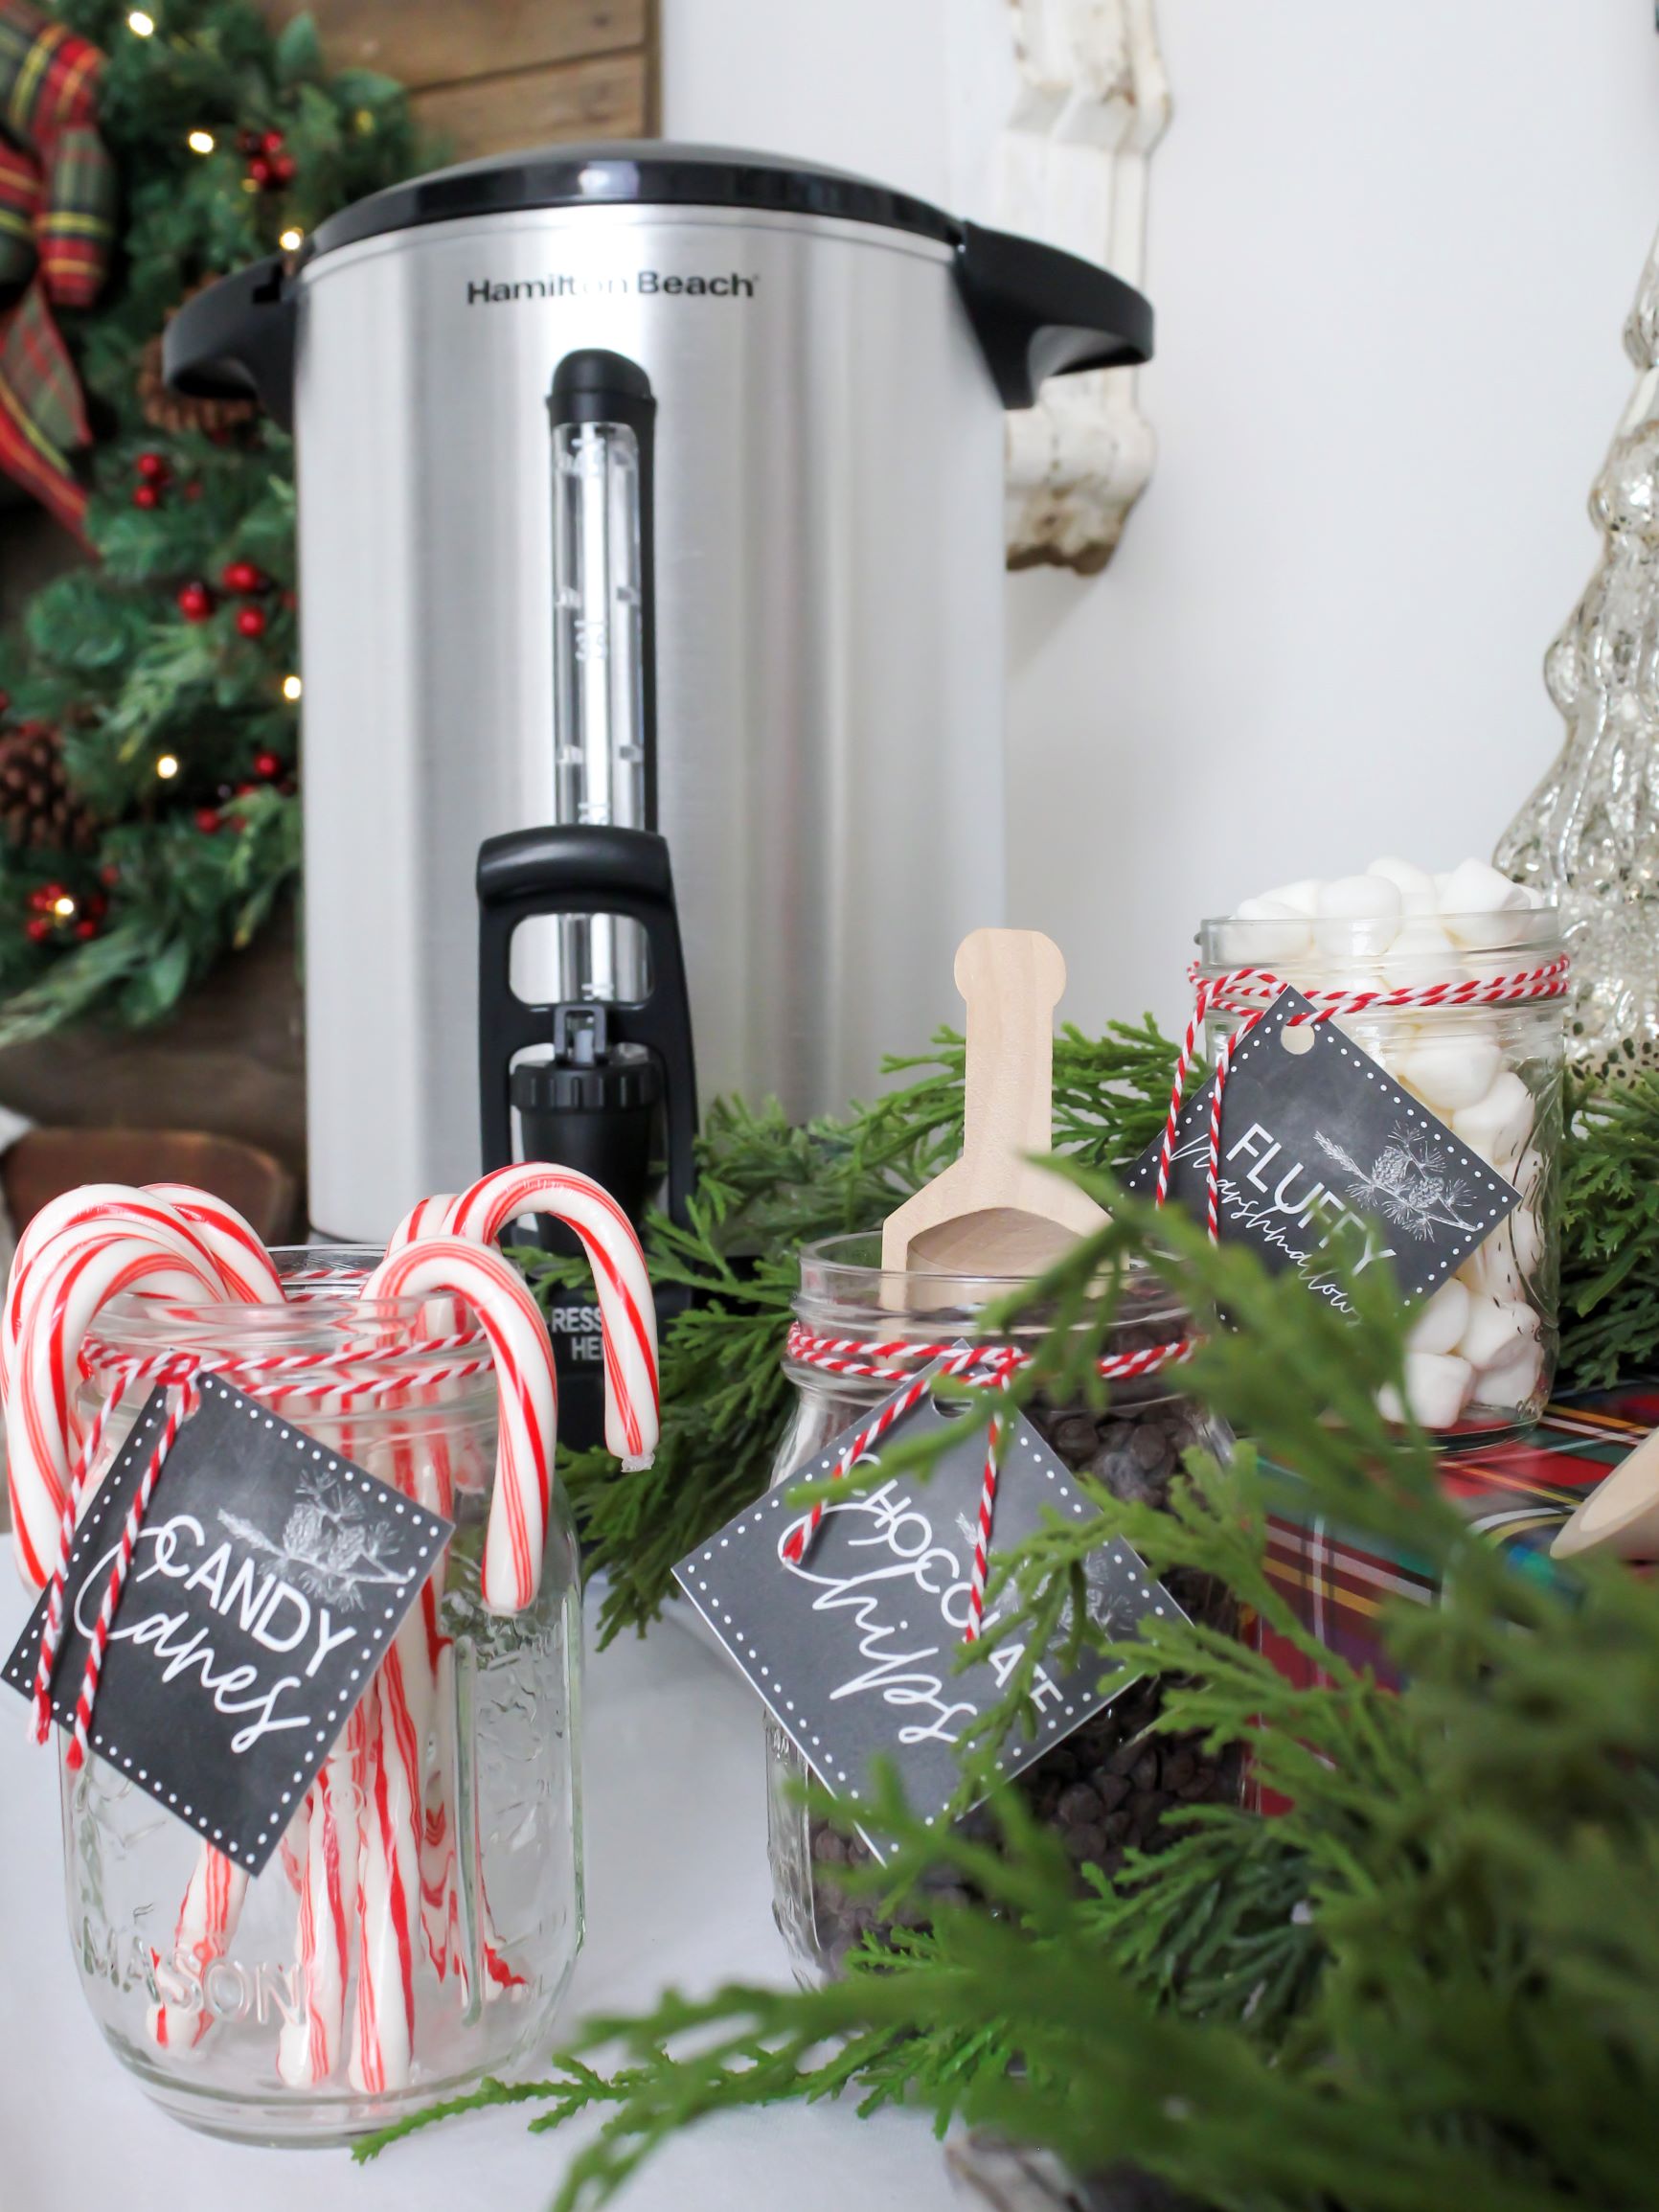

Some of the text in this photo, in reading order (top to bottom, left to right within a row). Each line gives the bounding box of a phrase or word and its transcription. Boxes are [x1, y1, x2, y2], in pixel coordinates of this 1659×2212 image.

[637, 270, 754, 297] Beach
[1225, 1123, 1397, 1276] FLUFFY
[551, 1307, 602, 1334] RESS
[571, 1336, 603, 1361] HE
[74, 1526, 310, 1754] Canes
[154, 1515, 356, 1678] CANDY
[777, 1502, 979, 1745] Chips
